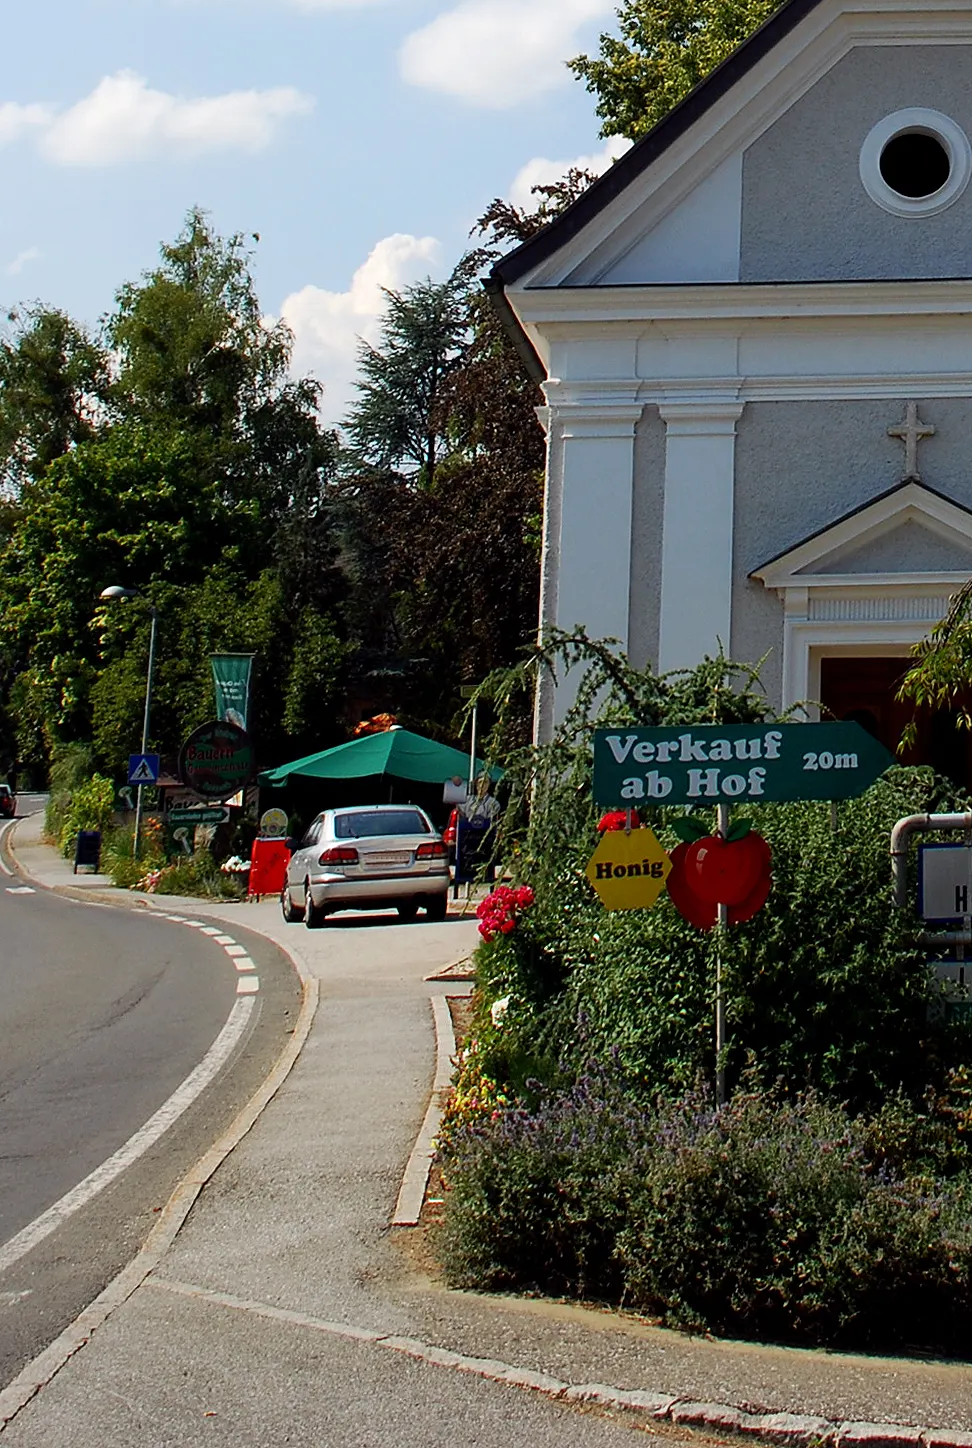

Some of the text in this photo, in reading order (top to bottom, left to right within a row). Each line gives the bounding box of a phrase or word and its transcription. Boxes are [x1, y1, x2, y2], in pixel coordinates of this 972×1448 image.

[604, 730, 783, 764] Verkauf
[802, 751, 859, 771] 20m
[620, 767, 767, 799] ab Hof
[595, 858, 664, 879] Honig
